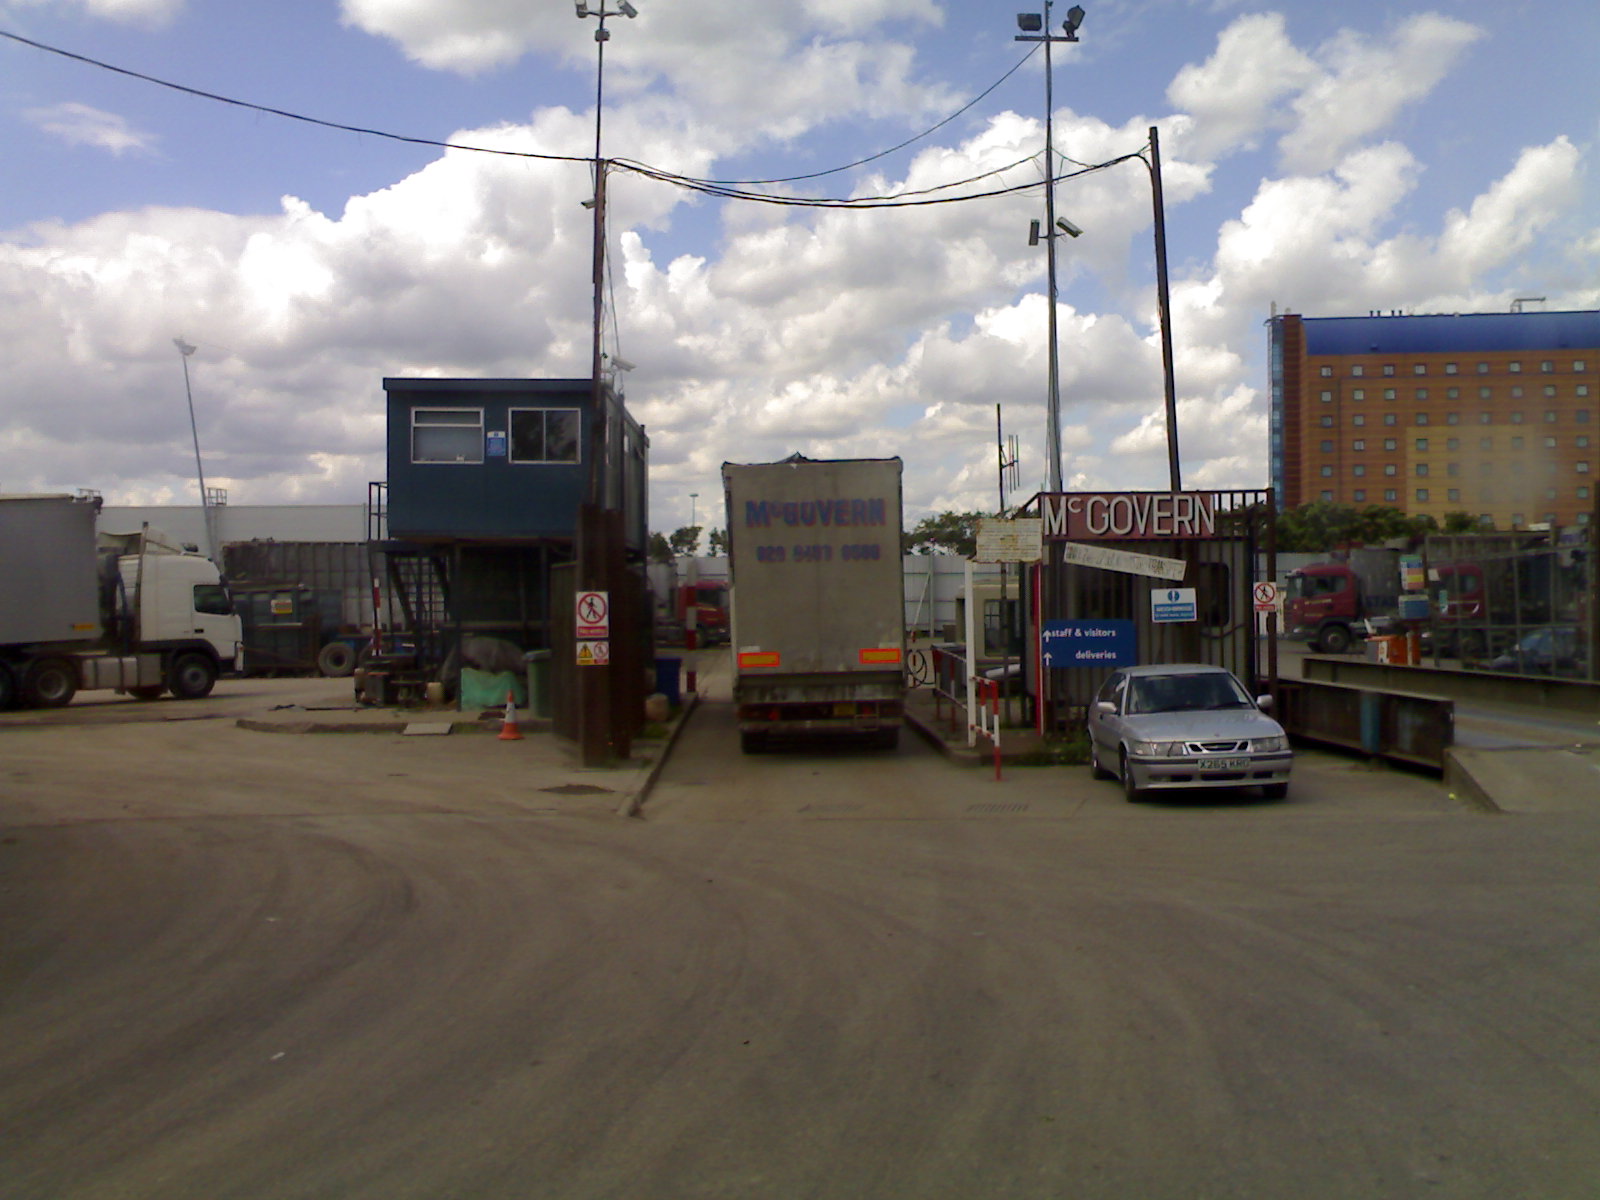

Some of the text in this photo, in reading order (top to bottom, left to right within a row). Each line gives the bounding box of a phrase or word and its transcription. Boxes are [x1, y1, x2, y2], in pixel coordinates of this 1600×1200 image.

[1051, 628, 1117, 637] staff & visitors
[1075, 650, 1117, 660] deliveries
